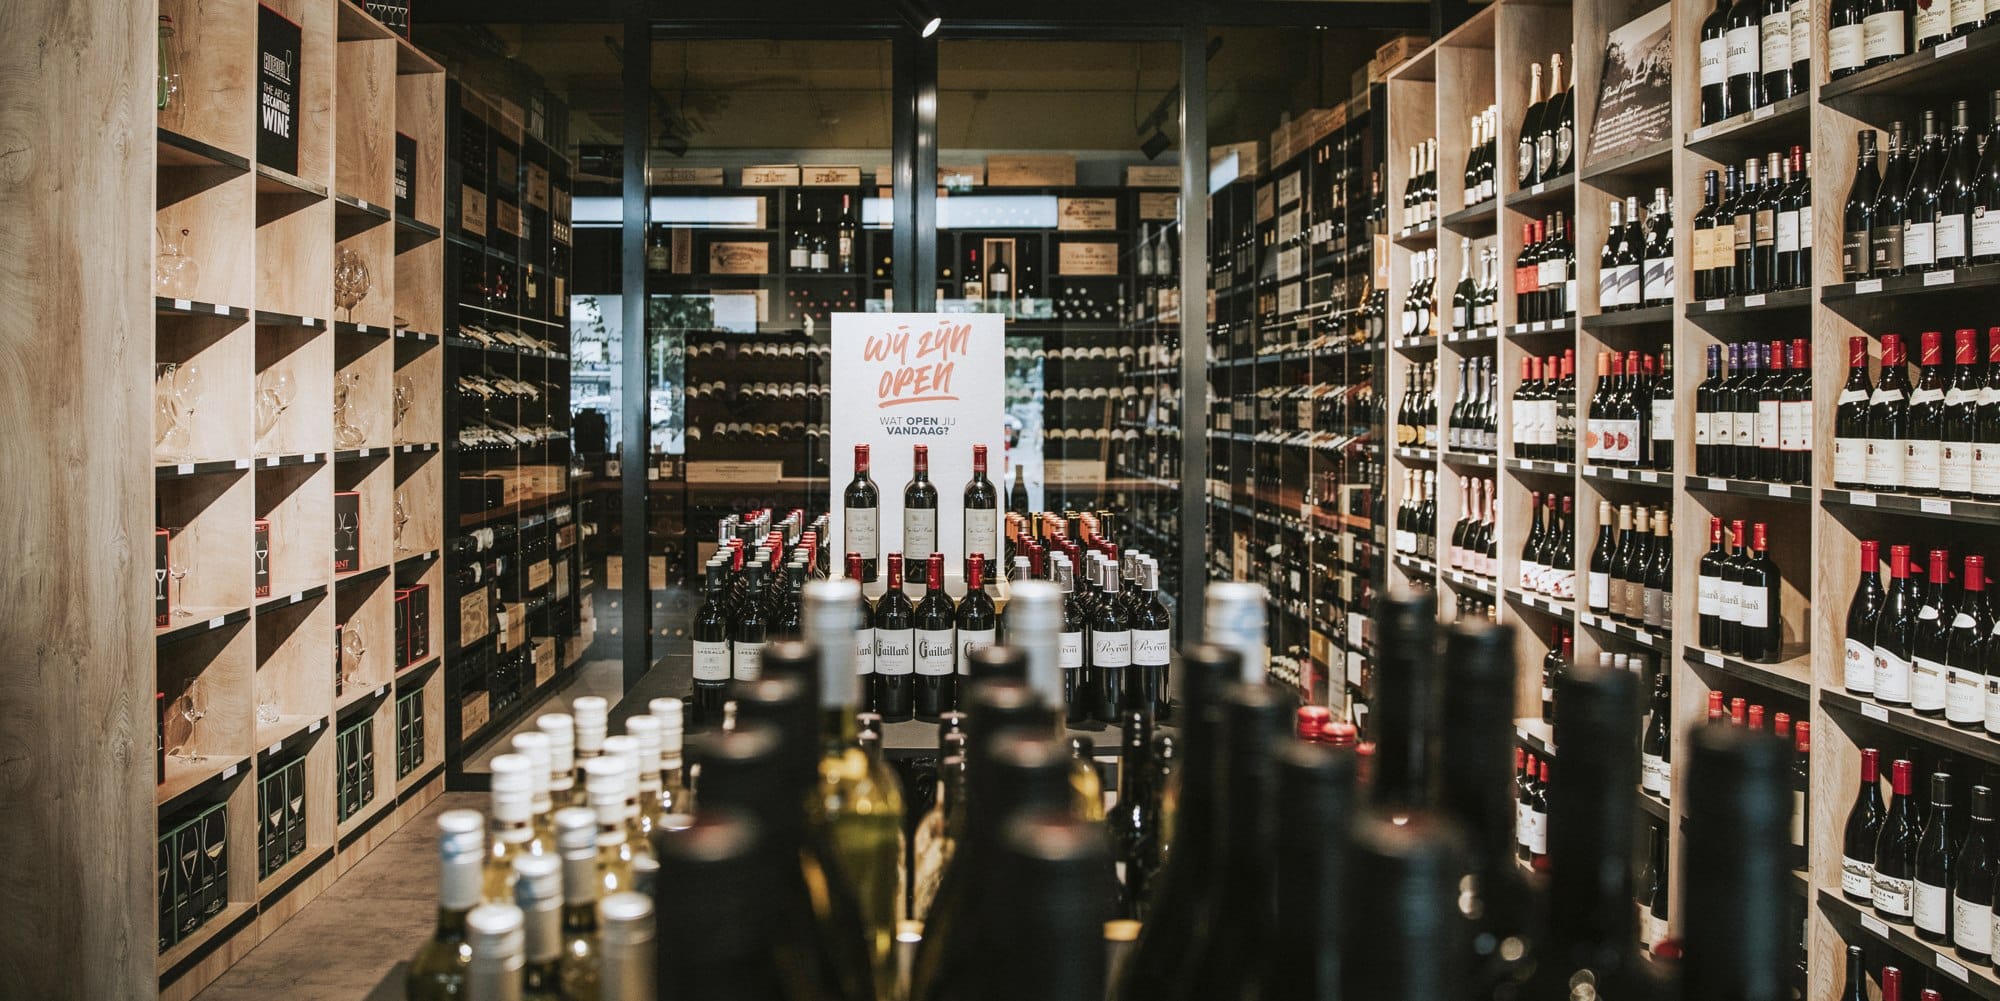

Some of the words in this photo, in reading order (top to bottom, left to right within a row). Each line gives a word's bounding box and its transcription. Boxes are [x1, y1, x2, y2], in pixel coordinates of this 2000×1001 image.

[263, 82, 274, 95] THE
[274, 87, 283, 100] ART
[283, 91, 291, 103] OF
[263, 92, 291, 115] DECANTING
[262, 104, 290, 139] WINE
[878, 361, 954, 399] OPEN
[880, 416, 904, 426] WAT
[906, 416, 938, 426] OPEN
[941, 416, 956, 427] JIJ
[886, 426, 949, 436] VANDAAG?
[875, 639, 909, 658] Gaillard
[919, 639, 952, 659] Gaillard
[1096, 640, 1129, 655] Peyrou
[1134, 639, 1167, 655] Peyrou
